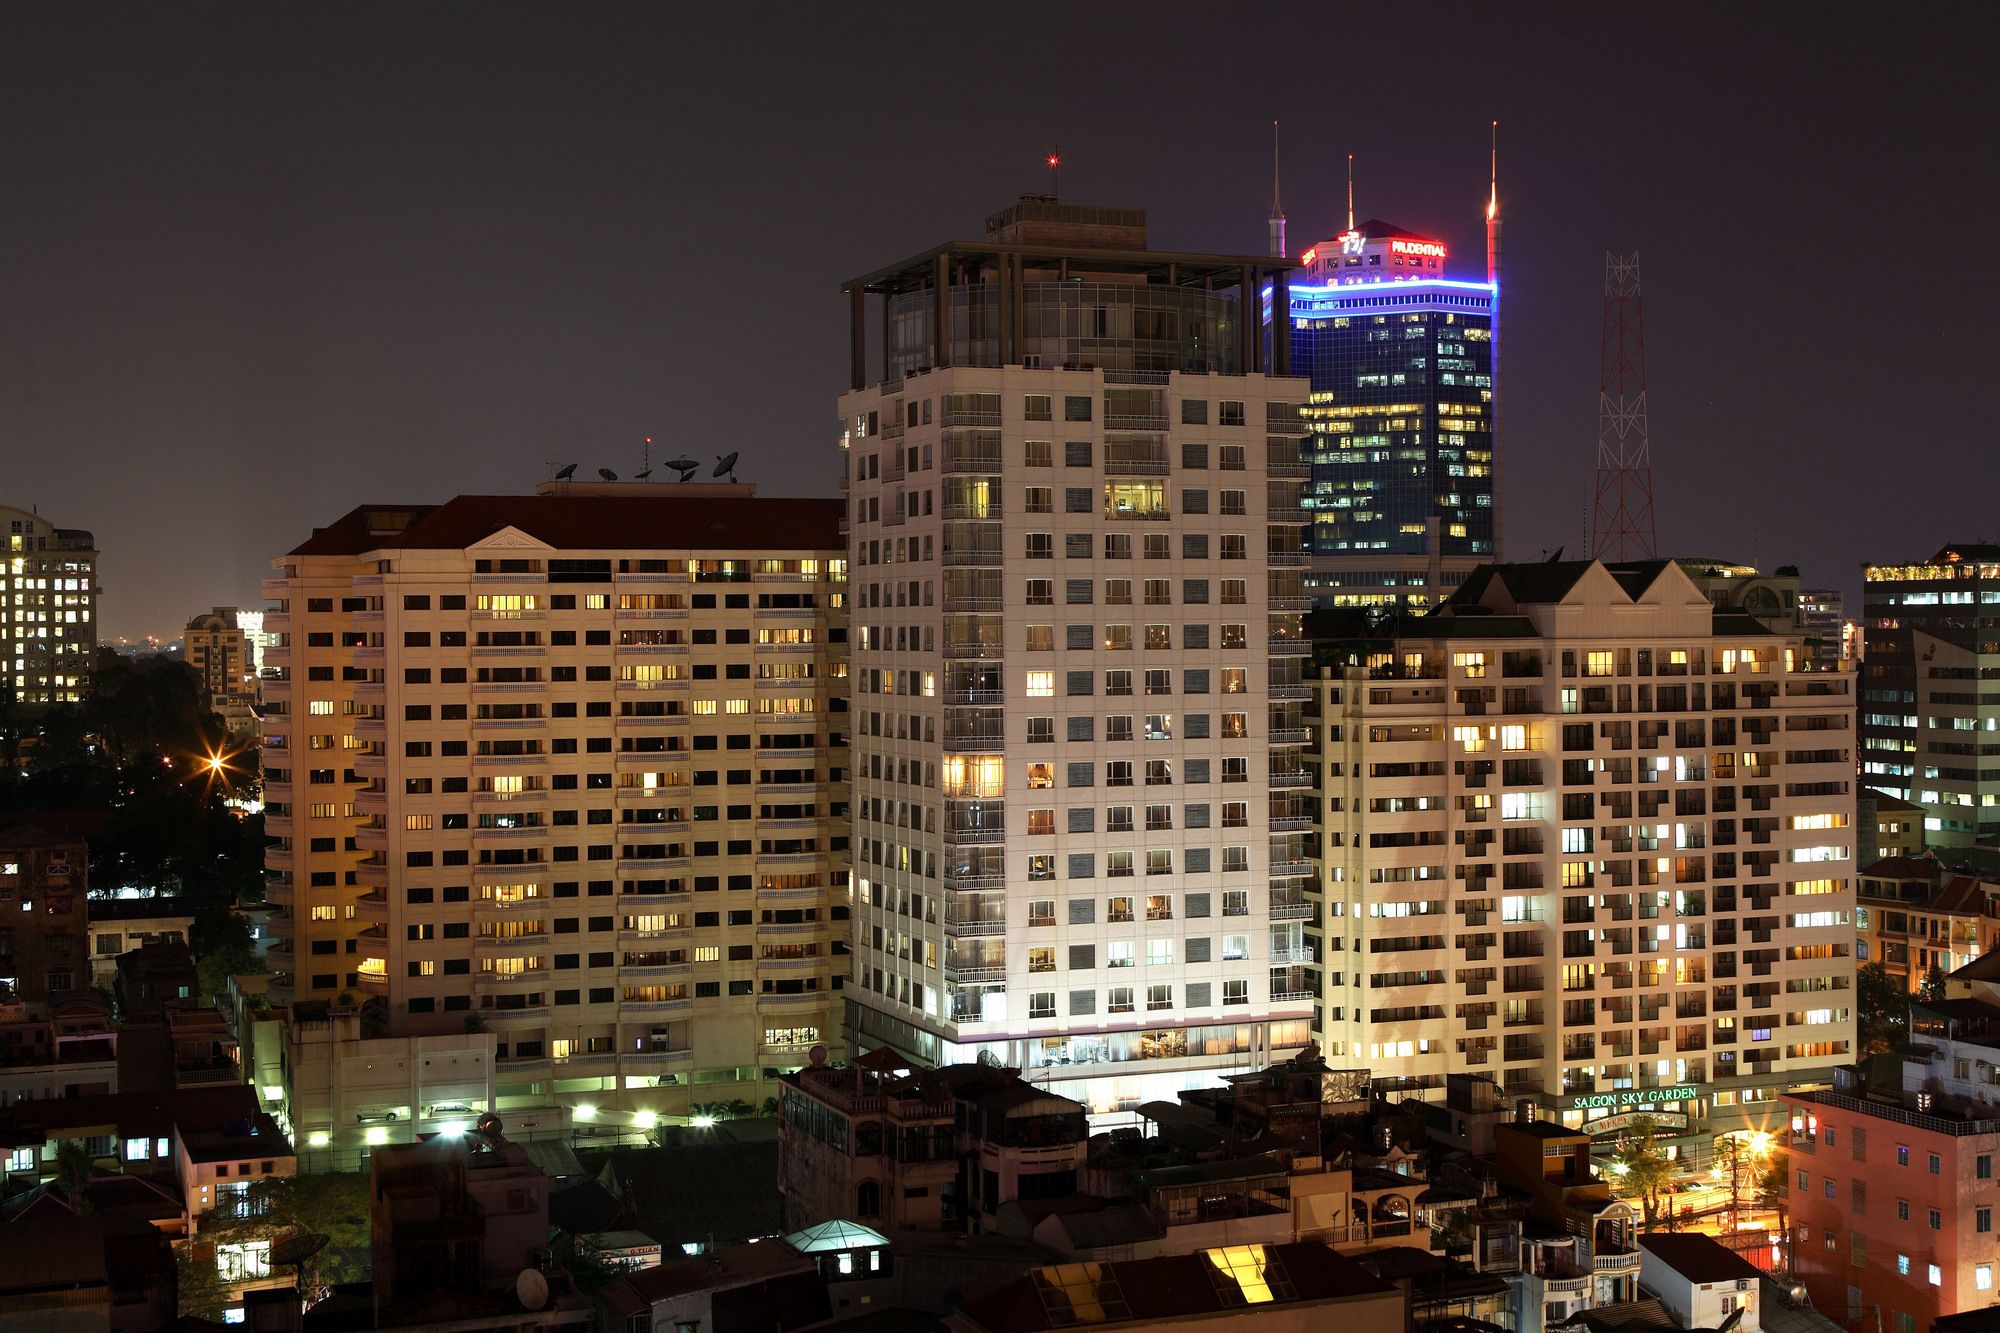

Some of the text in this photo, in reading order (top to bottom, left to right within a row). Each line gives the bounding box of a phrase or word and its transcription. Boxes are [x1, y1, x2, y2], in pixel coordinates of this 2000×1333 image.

[1392, 241, 1445, 256] PRUDENTIAL
[1574, 1088, 1696, 1108] SAIGON SKY GARDEN
